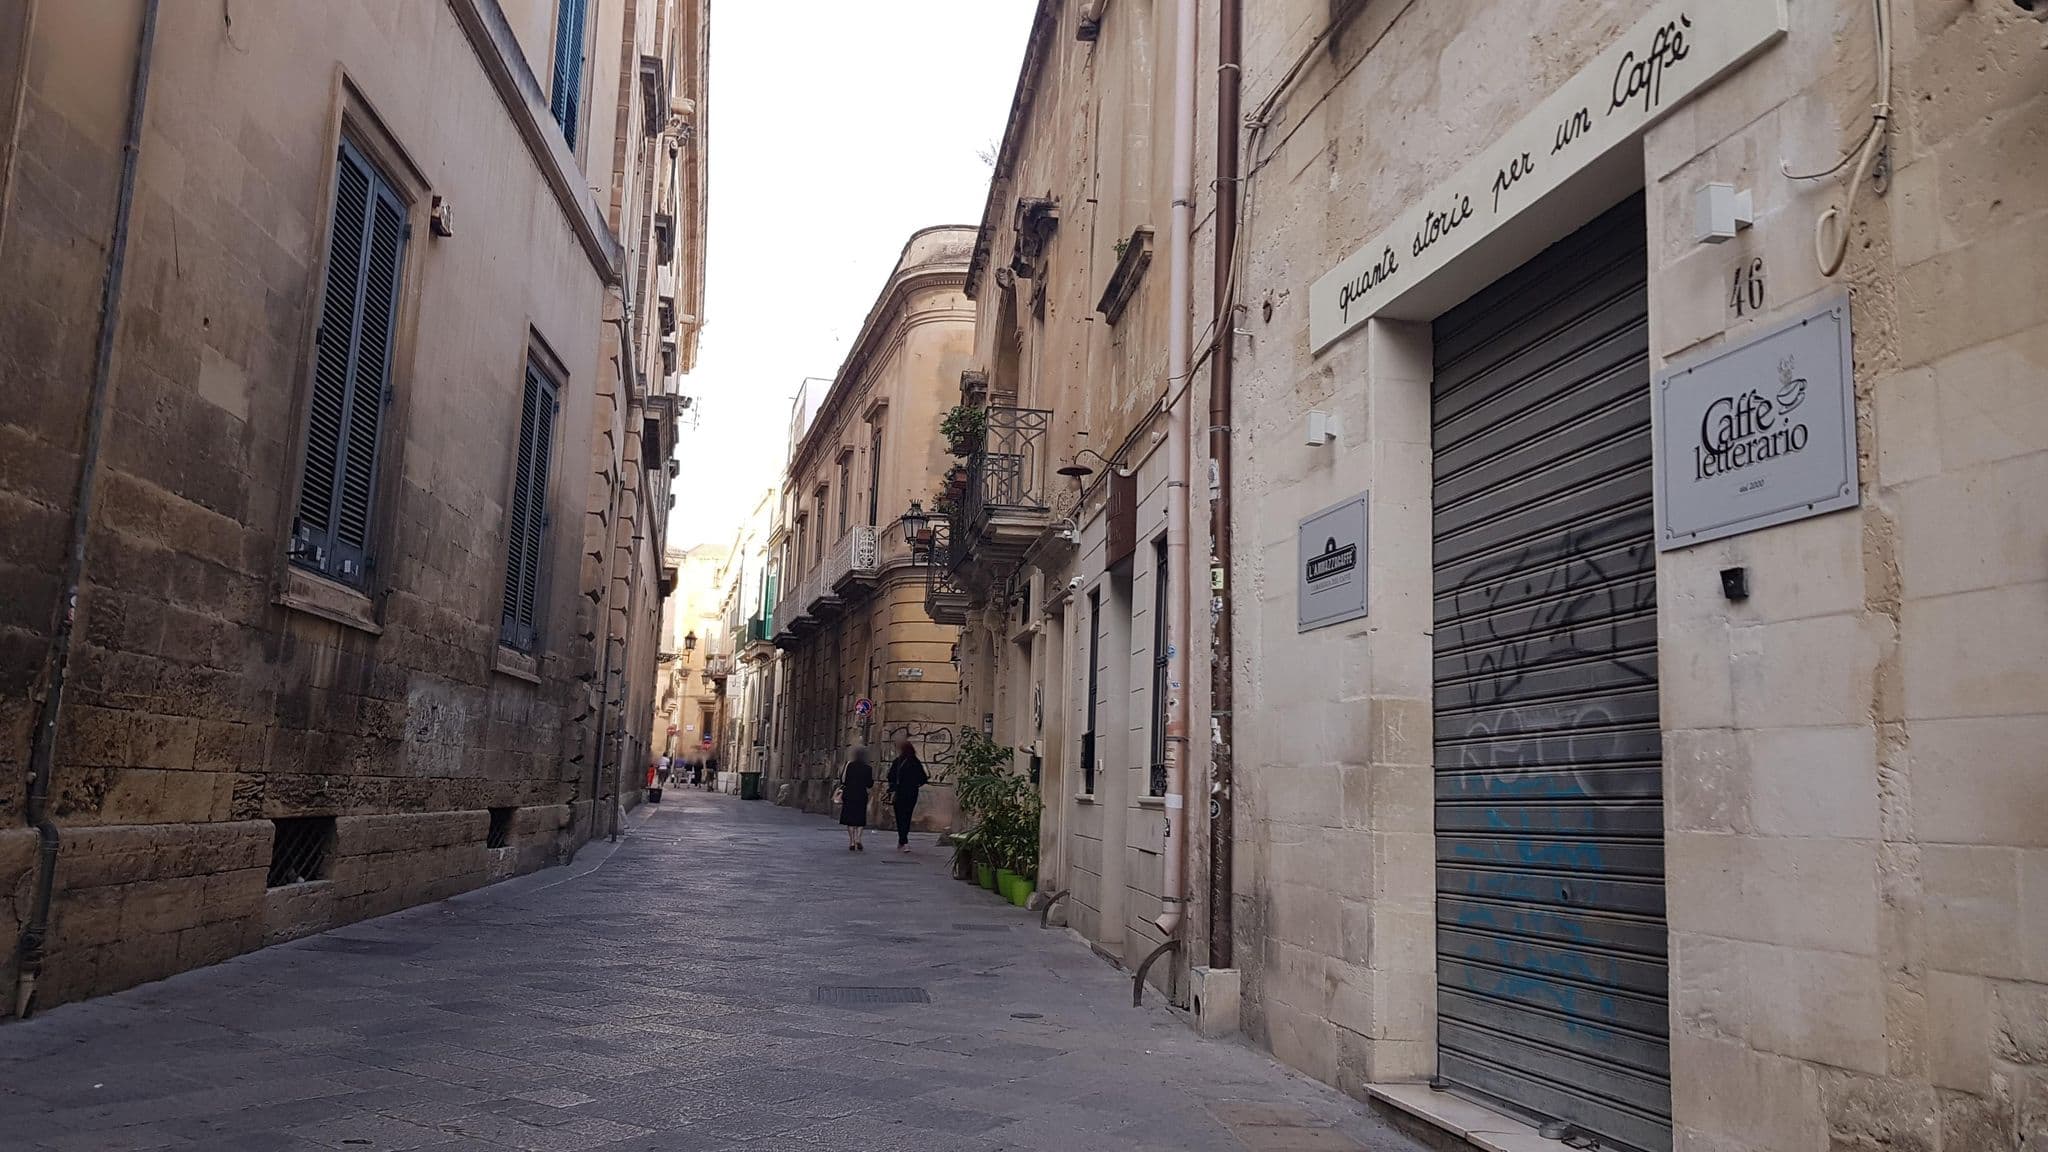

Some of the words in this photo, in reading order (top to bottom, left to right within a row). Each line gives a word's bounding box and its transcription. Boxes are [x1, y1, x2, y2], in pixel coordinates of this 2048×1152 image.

[1340, 245, 1399, 323] quante
[1413, 193, 1473, 257] storie
[1492, 152, 1534, 213] per
[1551, 107, 1592, 156] un
[1606, 13, 1691, 117] Caffè
[1729, 257, 1764, 317] 46
[1694, 418, 1808, 480] letterario
[1701, 389, 1775, 455] Caffè
